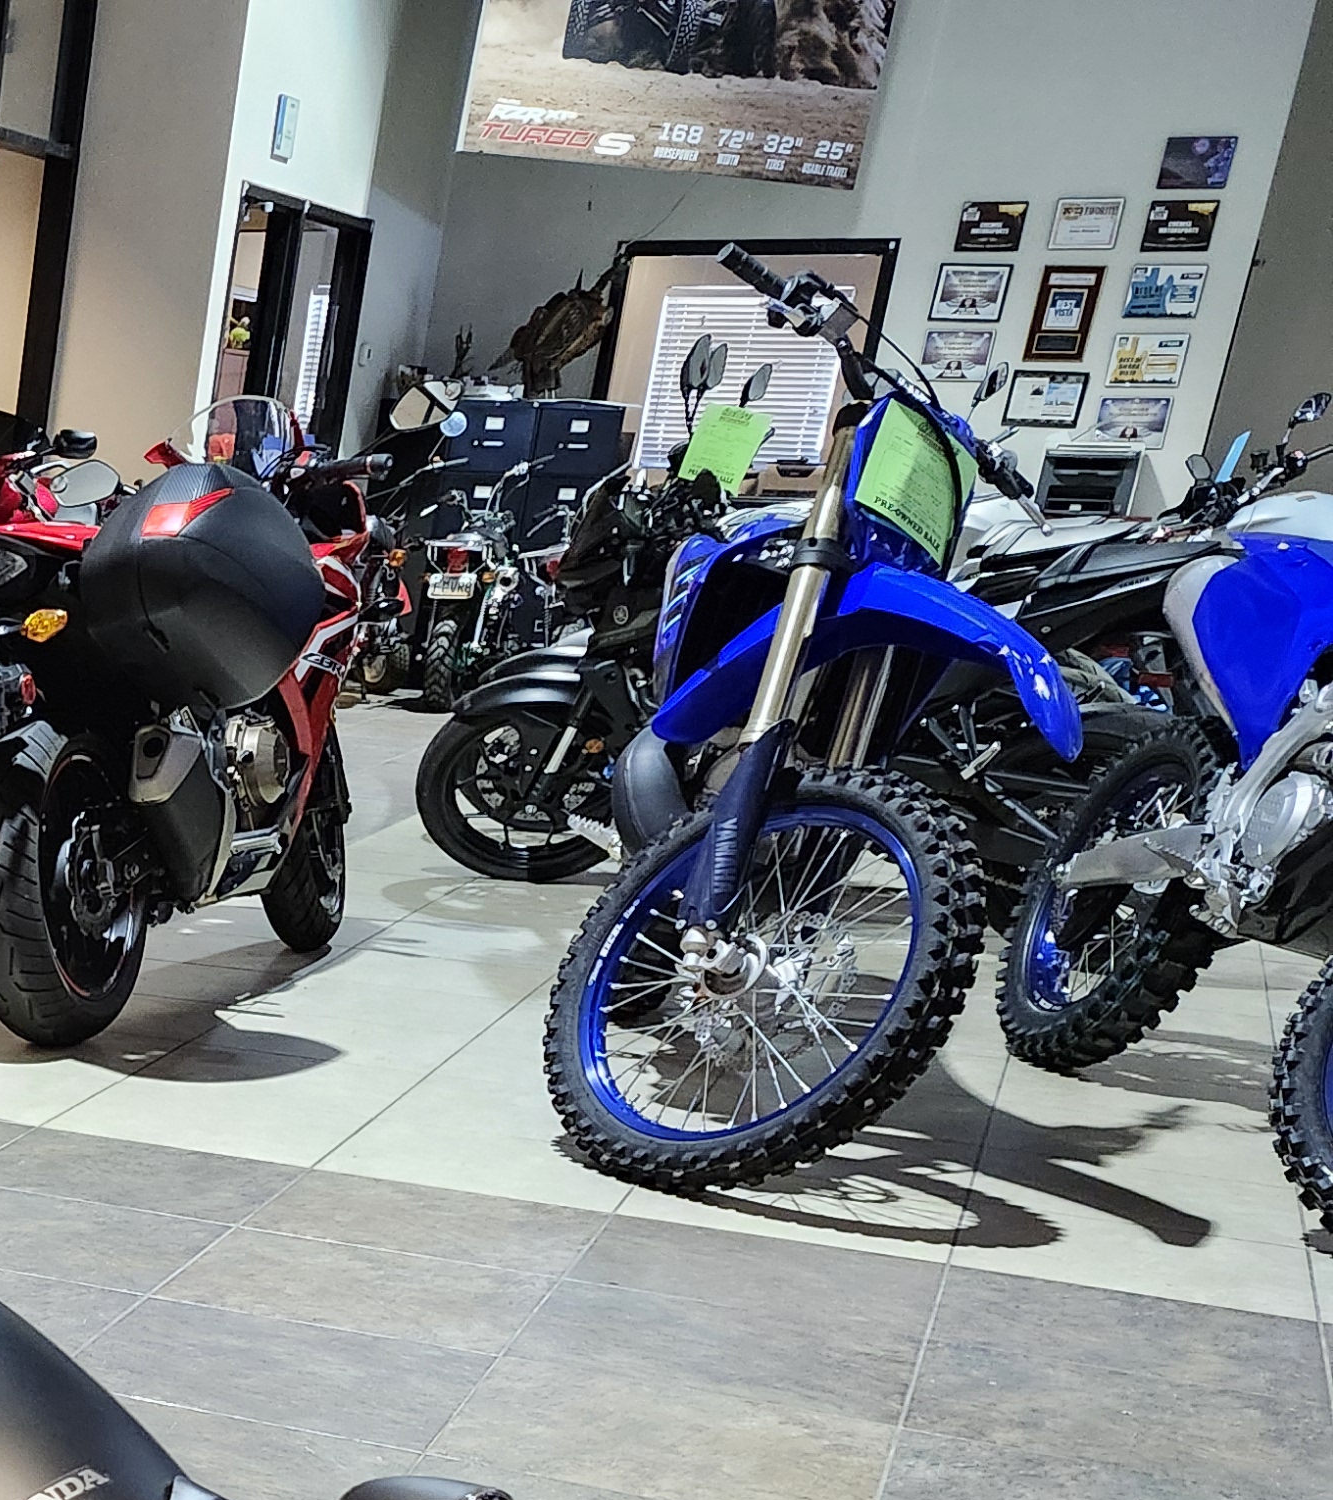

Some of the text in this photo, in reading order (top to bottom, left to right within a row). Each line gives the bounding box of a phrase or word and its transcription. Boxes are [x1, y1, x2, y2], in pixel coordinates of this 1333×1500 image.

[480, 121, 636, 156] TURBO S
[658, 122, 854, 161] 168 72" 32" 25"
[713, 817, 738, 894] YAMAHA
